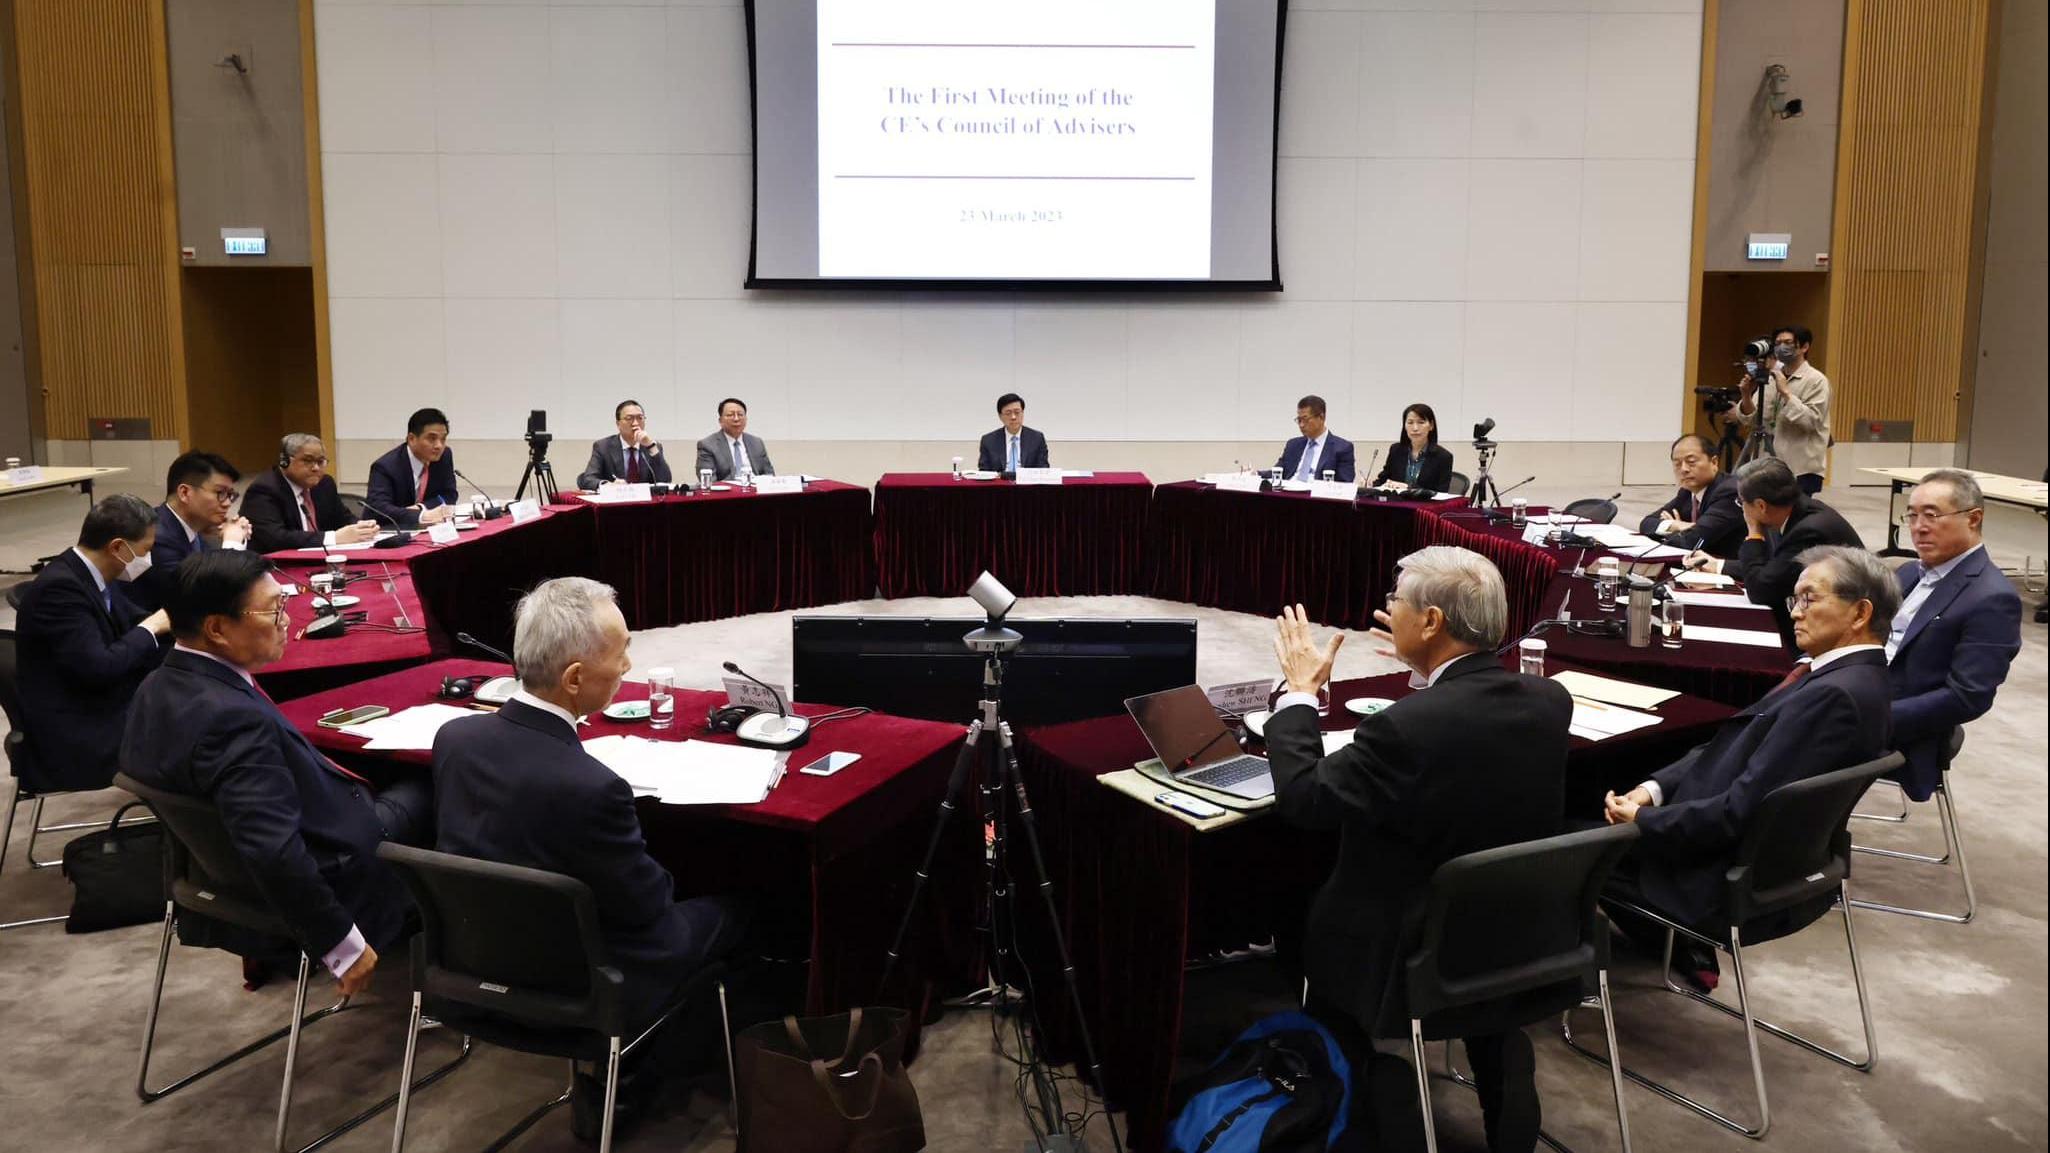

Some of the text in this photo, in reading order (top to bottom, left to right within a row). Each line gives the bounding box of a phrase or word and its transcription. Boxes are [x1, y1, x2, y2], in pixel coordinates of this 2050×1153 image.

[883, 86, 1133, 108] The First Meeting of the
[936, 116, 1016, 134] Council
[1022, 117, 1046, 134] of
[1049, 117, 1136, 135] Advisers
[960, 208, 1064, 223] 23 March 2023
